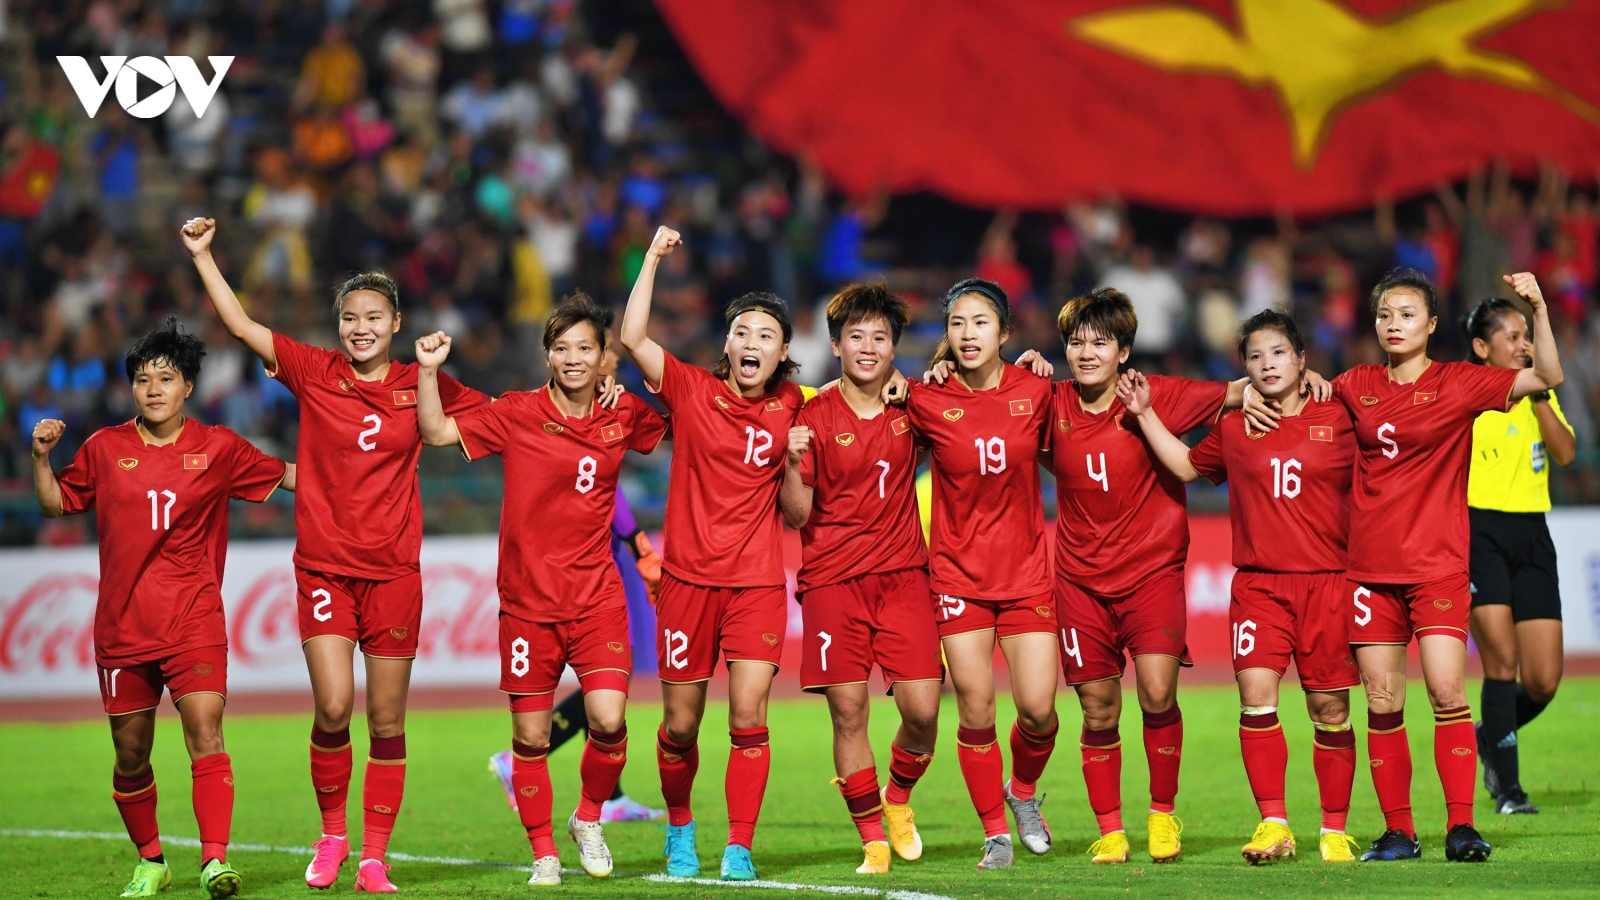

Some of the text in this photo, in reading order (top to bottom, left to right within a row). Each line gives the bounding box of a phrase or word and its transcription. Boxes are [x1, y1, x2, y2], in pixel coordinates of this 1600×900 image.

[358, 414, 382, 451] 2
[744, 426, 772, 467] 12
[1378, 422, 1398, 459] 5
[575, 456, 597, 494] 8
[975, 436, 1006, 475] 19
[1086, 453, 1108, 491] 4
[875, 460, 890, 498] 7
[1271, 458, 1301, 499] 16
[147, 489, 176, 530] 17
[312, 588, 332, 622] 2
[1353, 586, 1371, 626] 5
[511, 637, 529, 677] 8
[665, 629, 688, 669] 12
[817, 631, 831, 671] 7
[1062, 628, 1083, 667] 4
[1233, 620, 1257, 659] 16
